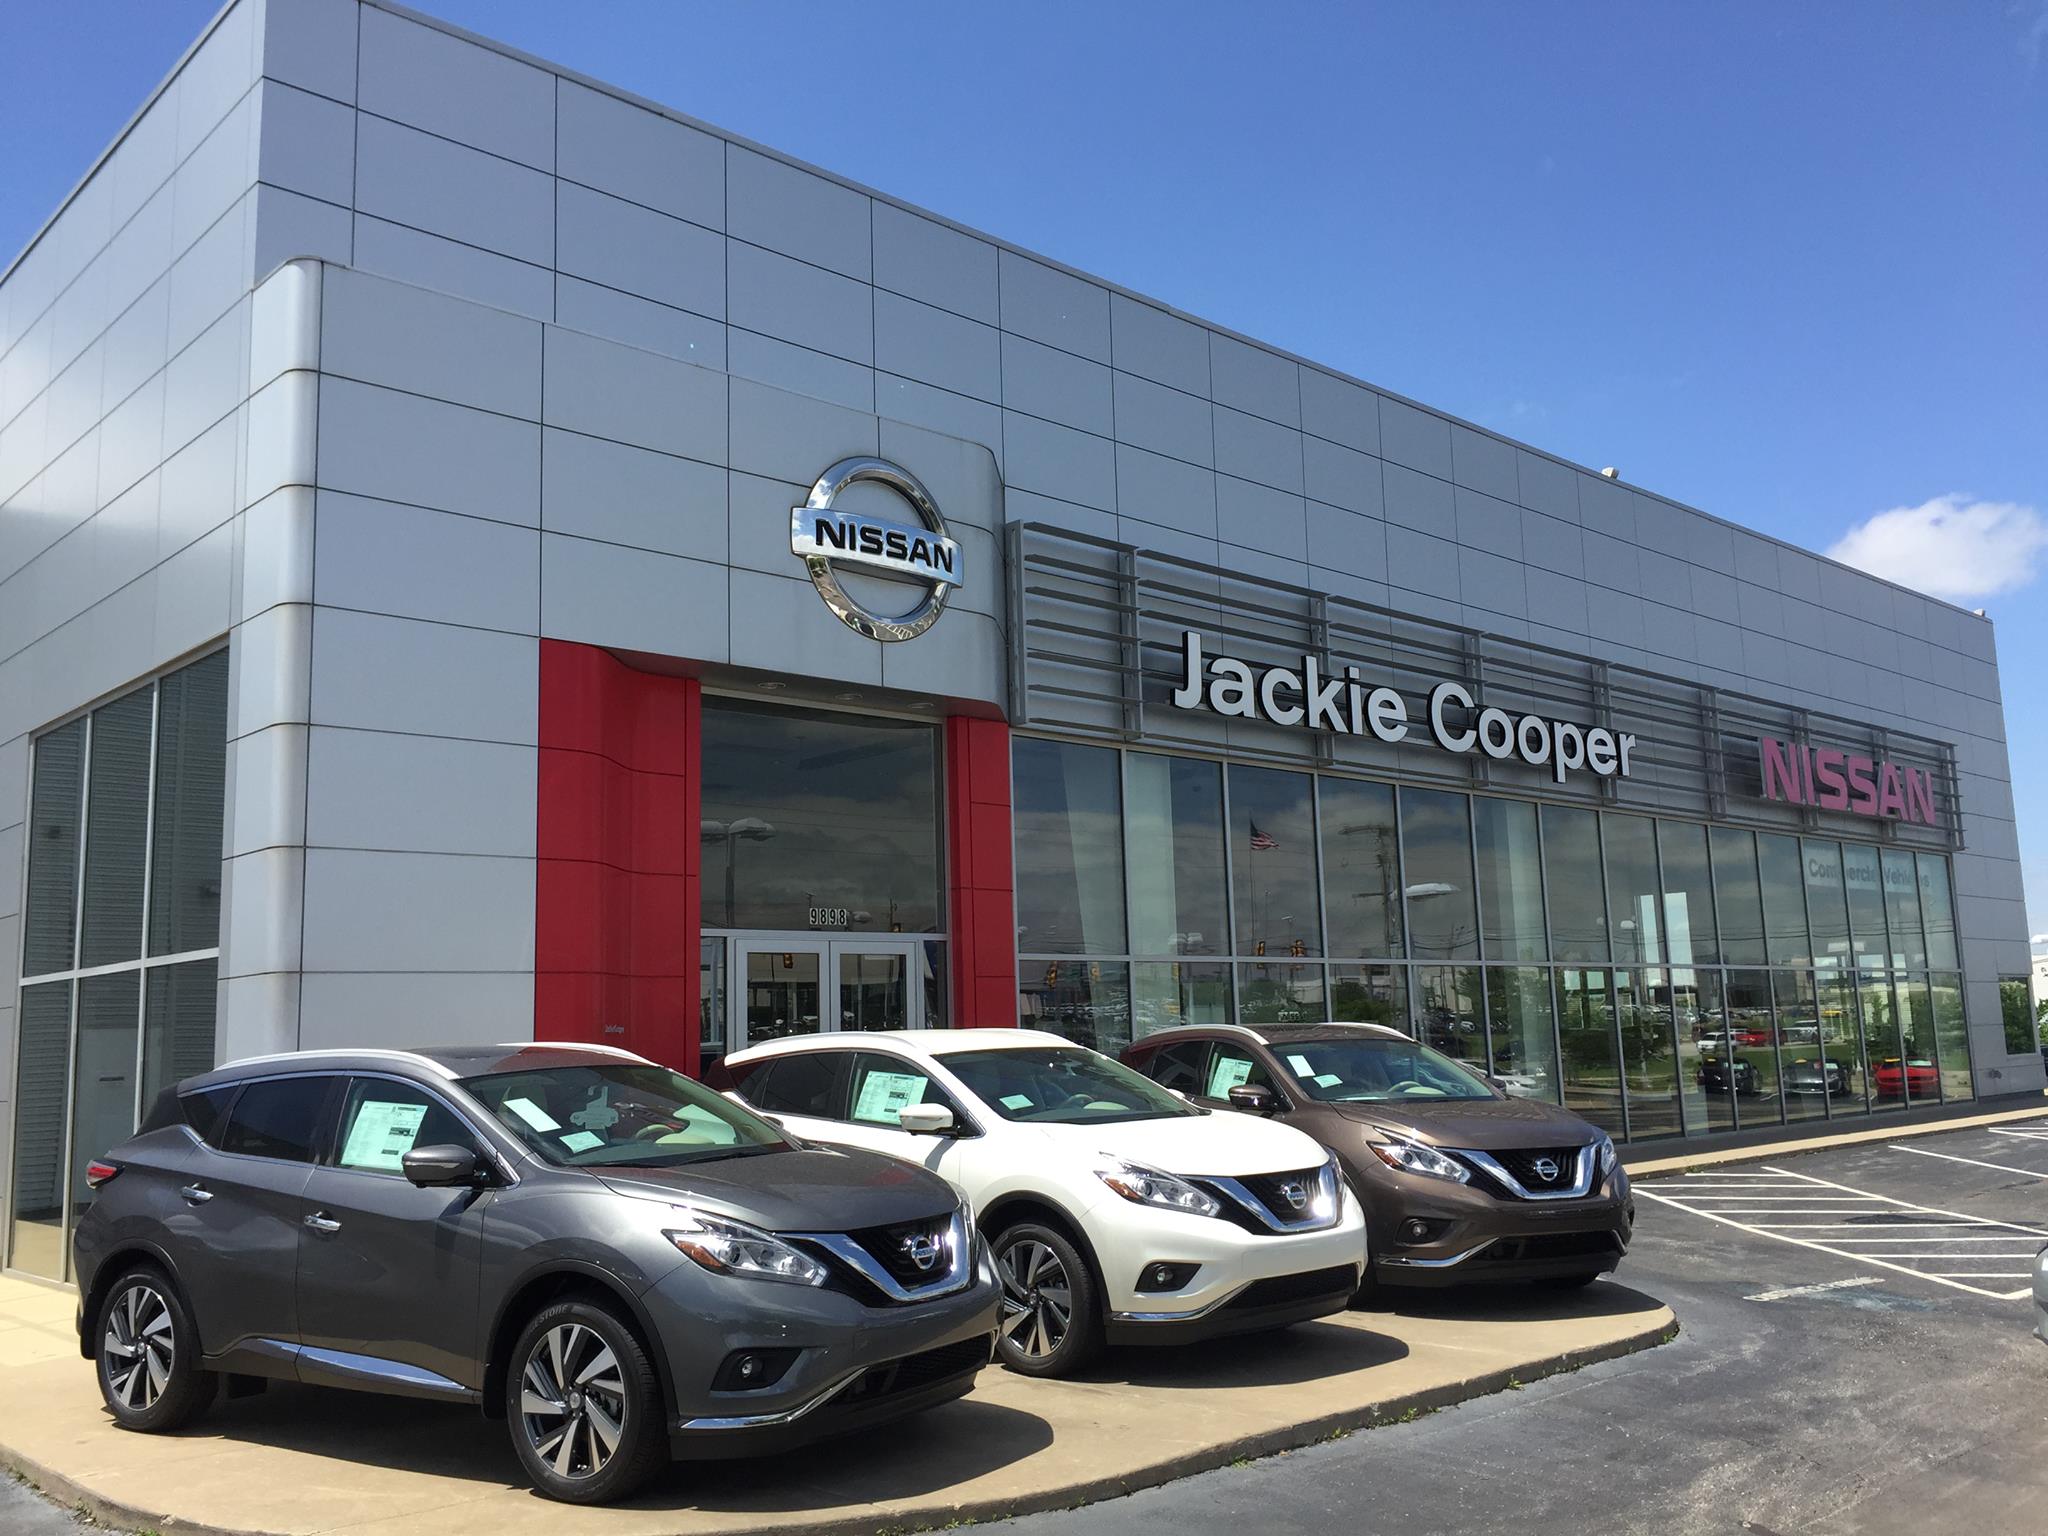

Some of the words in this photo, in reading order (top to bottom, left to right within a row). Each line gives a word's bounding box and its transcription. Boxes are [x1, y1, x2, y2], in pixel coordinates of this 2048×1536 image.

[815, 519, 953, 573] NISSAN
[1170, 630, 1409, 743] Jackie
[1427, 681, 1637, 784] Cooper
[1760, 736, 1937, 826] NISSAN
[810, 908, 846, 924] 9898
